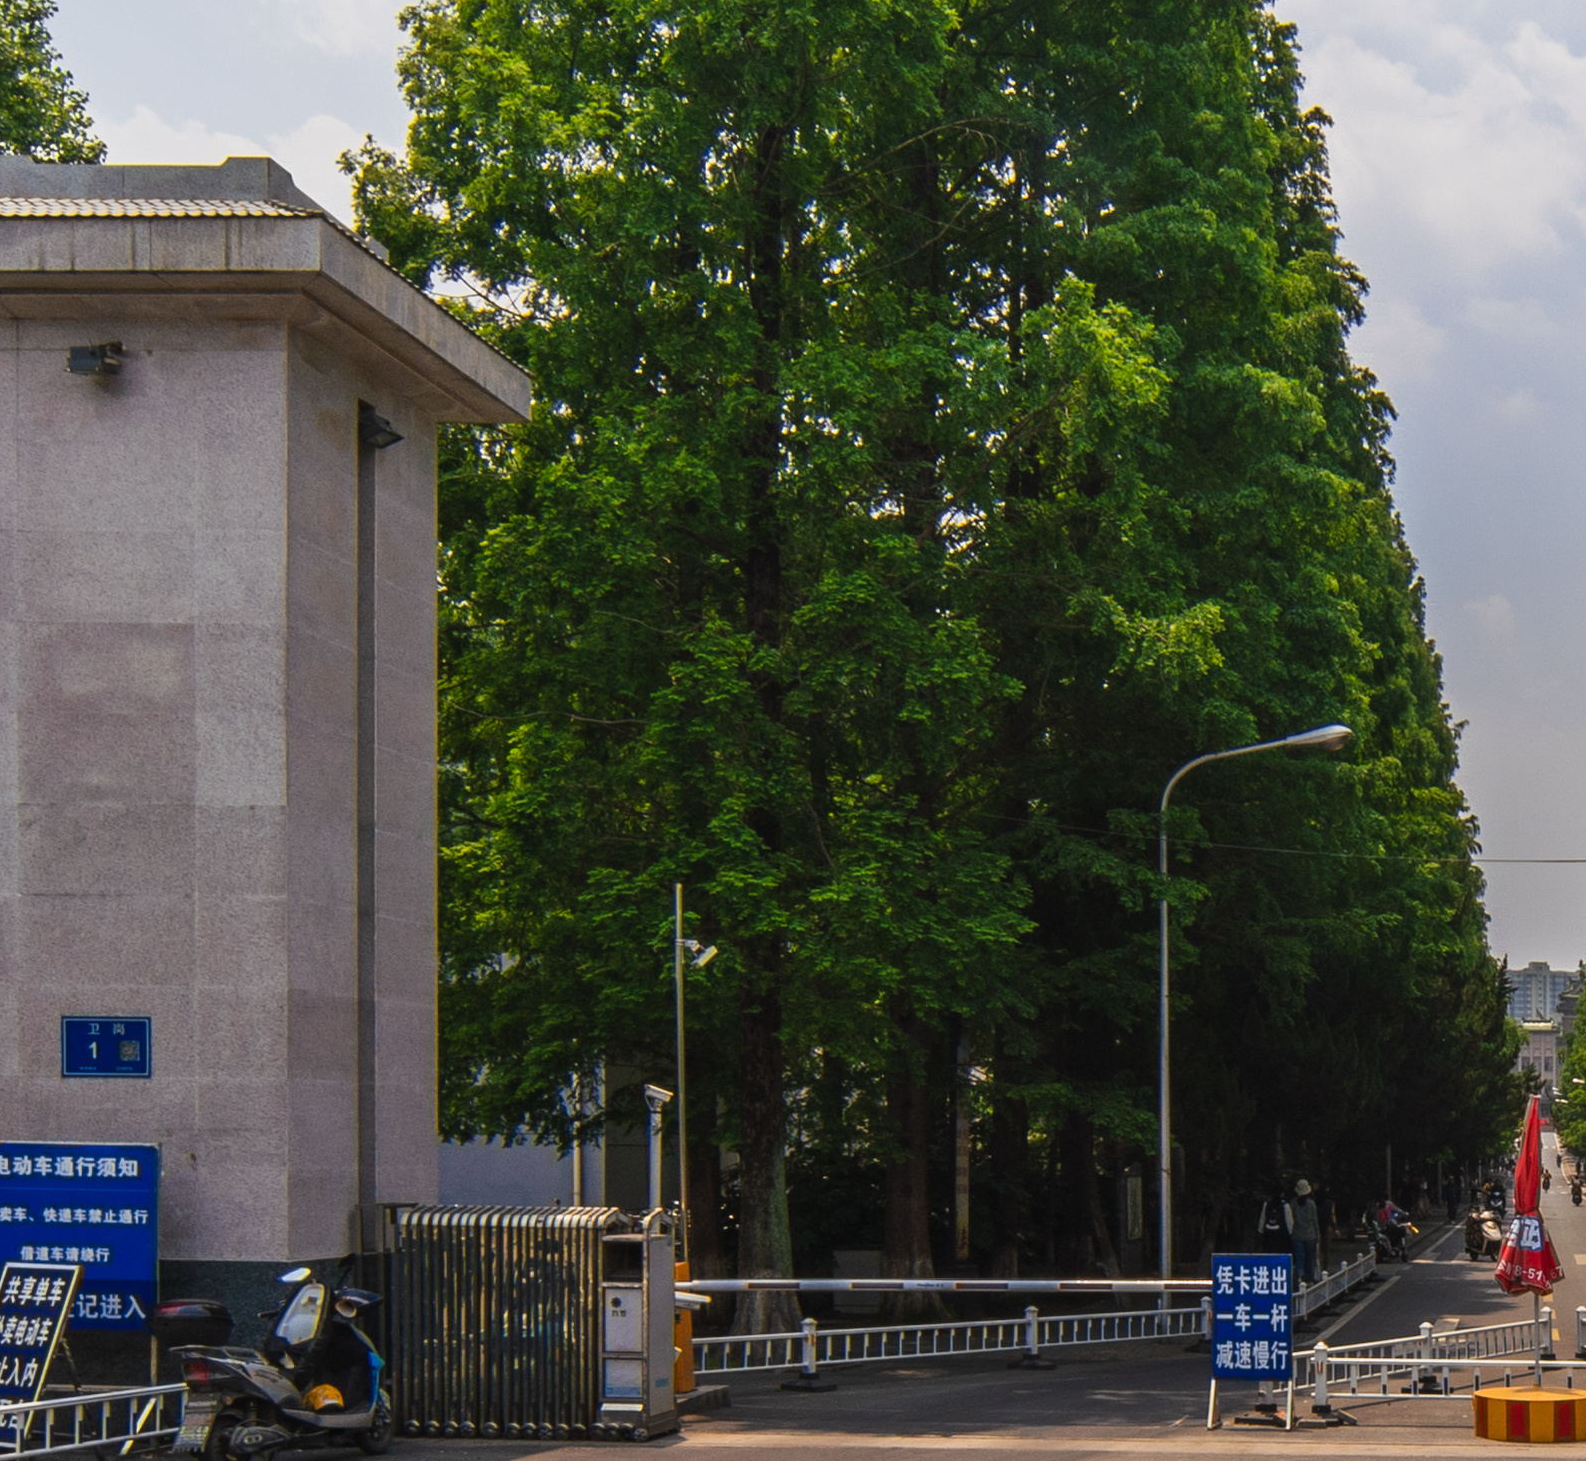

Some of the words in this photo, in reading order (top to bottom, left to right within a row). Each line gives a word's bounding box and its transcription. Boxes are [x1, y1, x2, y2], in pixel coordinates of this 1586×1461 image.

[88, 1023, 125, 1036] 卫岗
[88, 1041, 98, 1060] 1
[20, 1246, 111, 1262] 借道车请绕行
[2, 1275, 66, 1307] 共享单车
[1216, 1265, 1287, 1295] 凭卡进出
[1216, 1303, 1288, 1332] 一车一杆
[1216, 1340, 1288, 1370] 减速慢行
